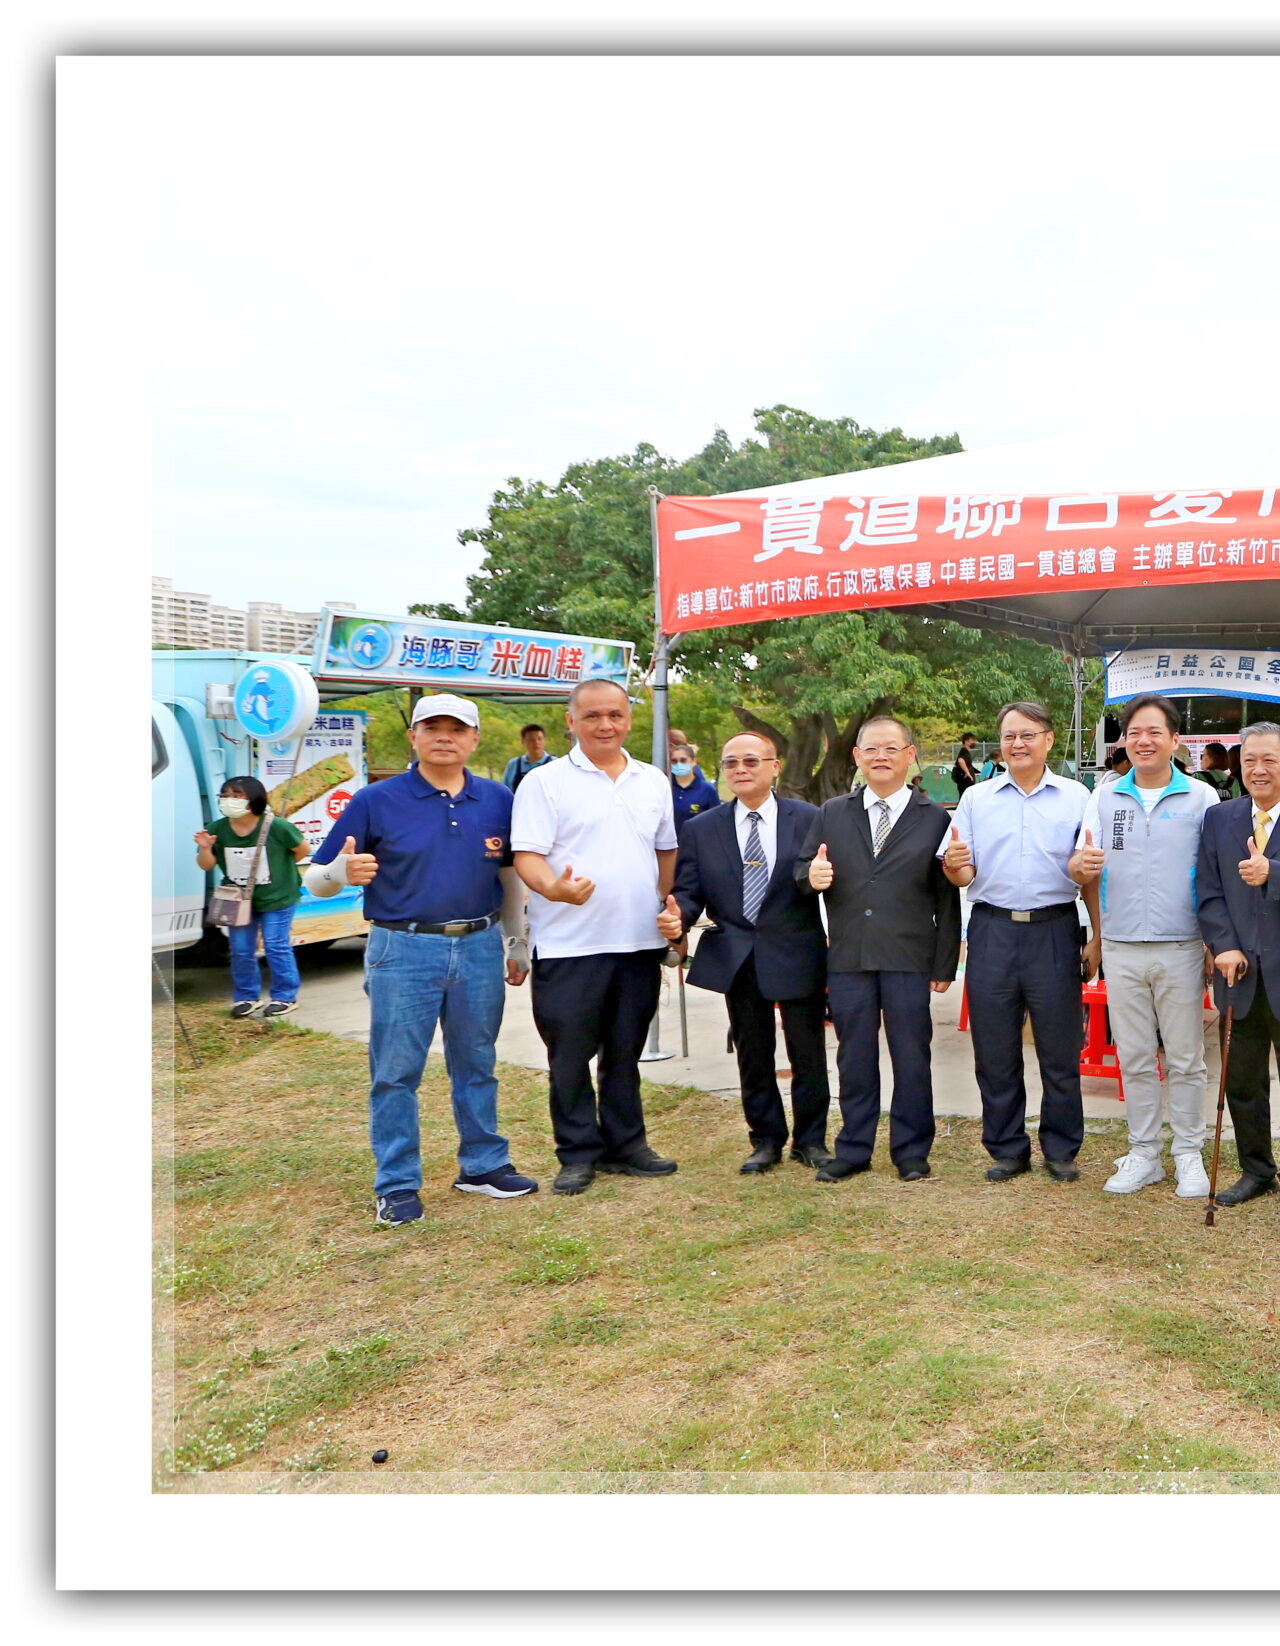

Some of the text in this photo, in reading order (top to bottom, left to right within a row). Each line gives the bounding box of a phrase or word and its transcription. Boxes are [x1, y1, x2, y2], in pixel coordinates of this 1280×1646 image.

[399, 634, 585, 681] 海豚哥 米血糕
[308, 716, 356, 731] 米血糕
[1112, 809, 1127, 850] 邱臣遠
